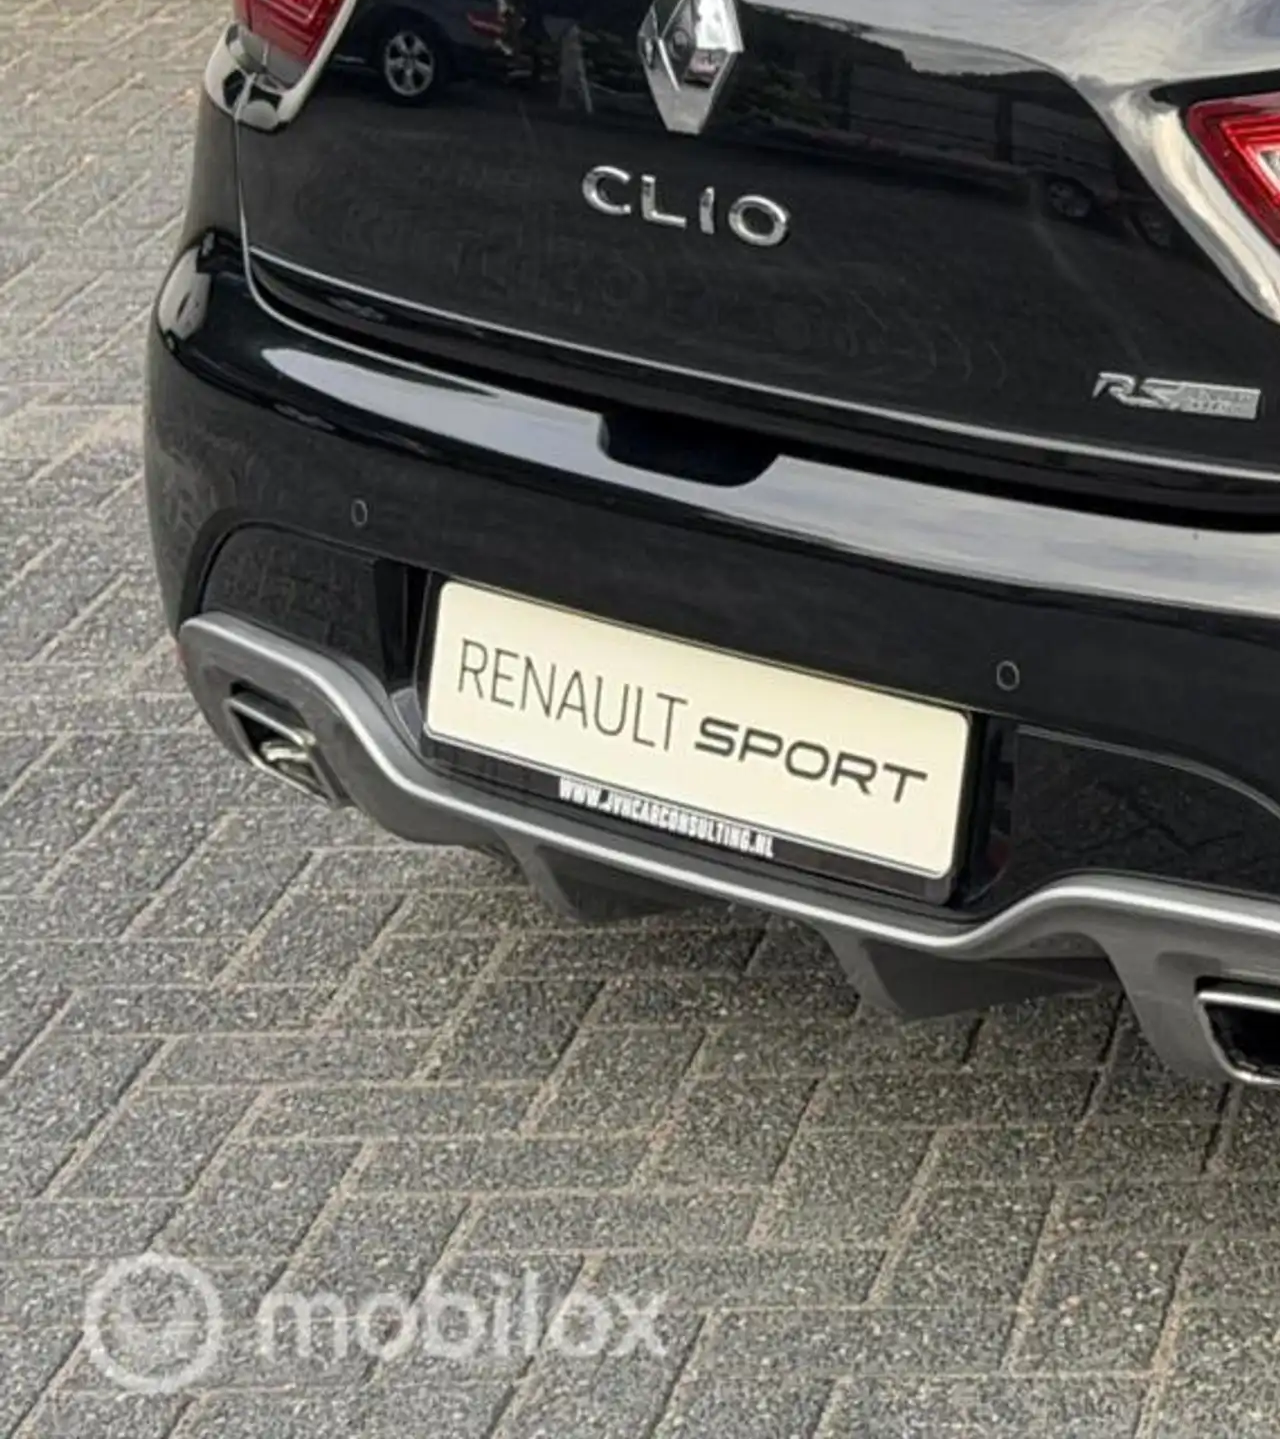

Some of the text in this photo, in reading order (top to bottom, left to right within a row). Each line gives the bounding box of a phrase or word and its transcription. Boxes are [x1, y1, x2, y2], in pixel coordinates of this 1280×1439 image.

[582, 165, 789, 247] CLIO
[458, 637, 929, 804] RENAULT SPORT
